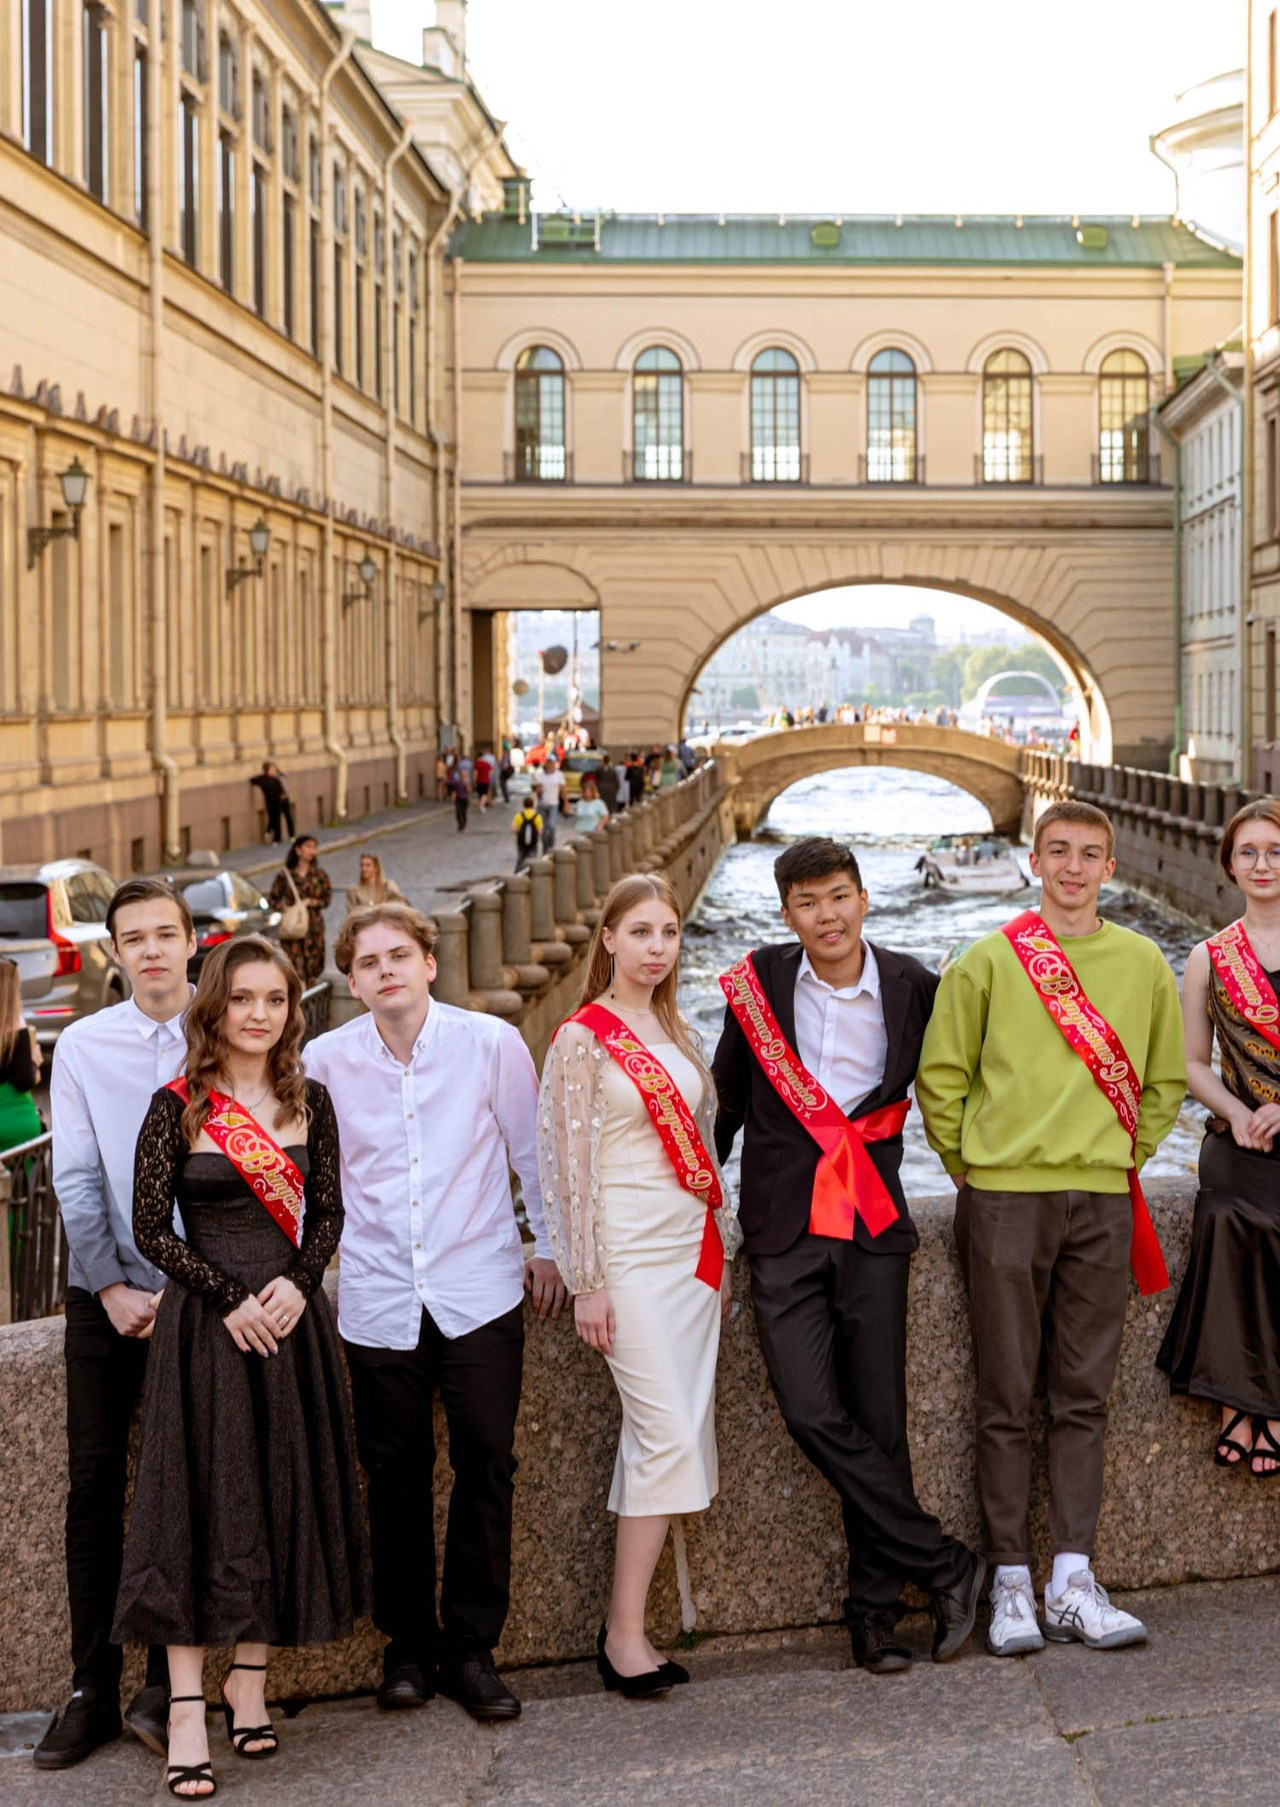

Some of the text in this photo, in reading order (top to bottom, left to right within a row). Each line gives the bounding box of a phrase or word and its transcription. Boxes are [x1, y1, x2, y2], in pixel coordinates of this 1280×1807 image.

[1029, 953, 1139, 1124] Выпускник 9 класс
[1244, 1005, 1279, 1024] 9
[624, 1053, 713, 1189] Выпускник 9
[761, 1039, 785, 1060] 9
[776, 1058, 817, 1106] класса
